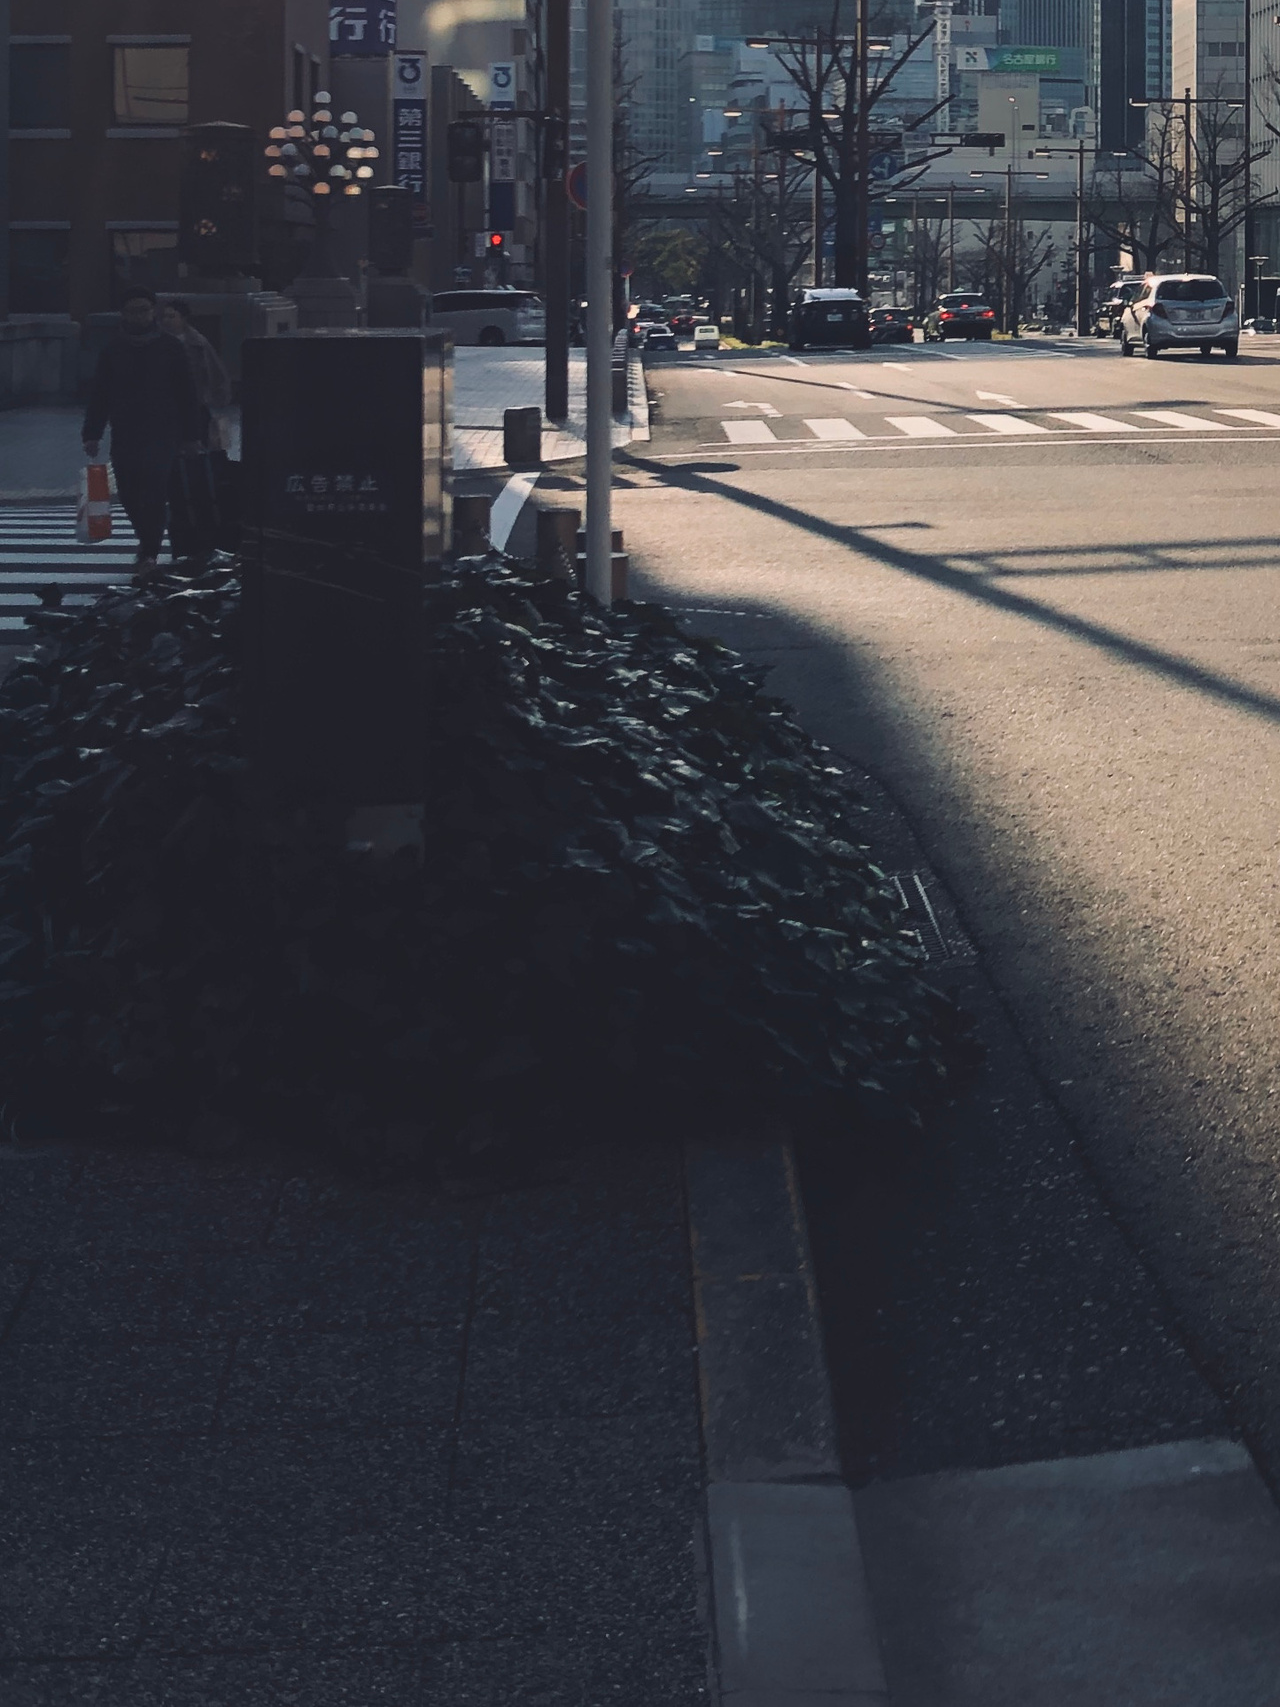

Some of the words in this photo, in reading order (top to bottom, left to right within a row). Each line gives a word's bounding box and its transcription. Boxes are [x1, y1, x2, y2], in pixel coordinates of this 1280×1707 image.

[1002, 53, 1057, 65] 名古屋銀行
[396, 107, 424, 194] 第三銀行
[284, 474, 380, 493] 広告禁止
